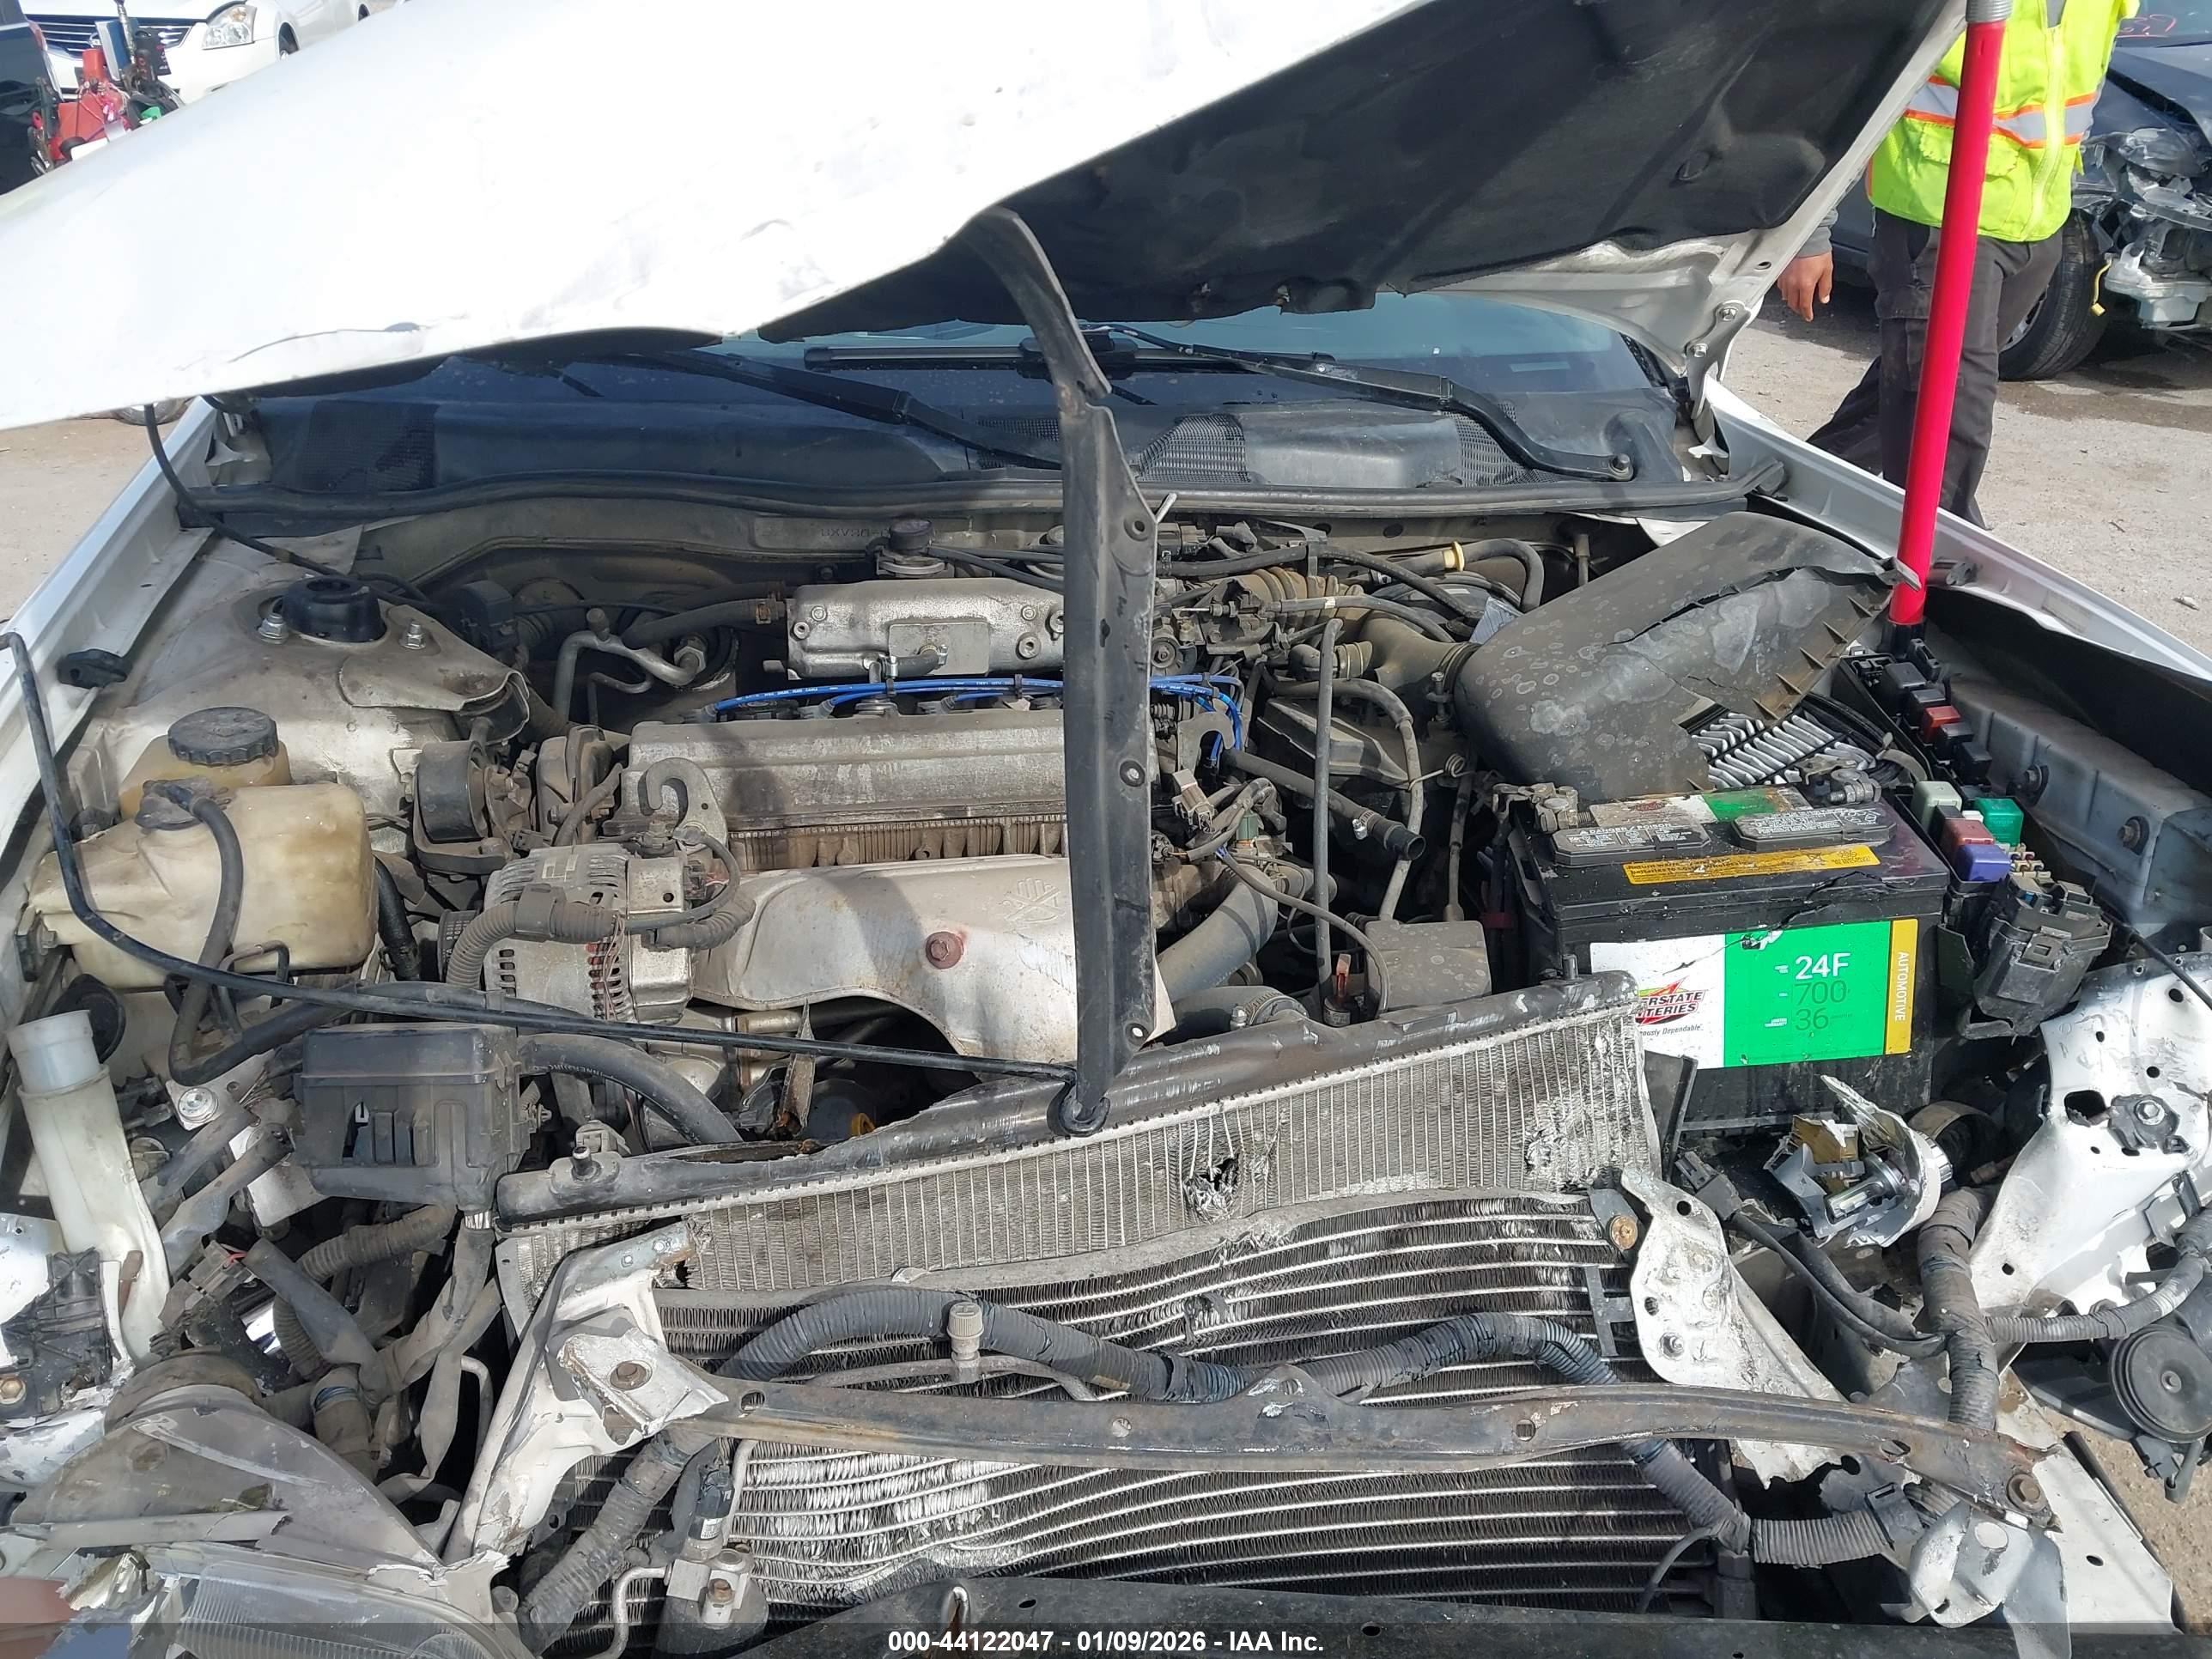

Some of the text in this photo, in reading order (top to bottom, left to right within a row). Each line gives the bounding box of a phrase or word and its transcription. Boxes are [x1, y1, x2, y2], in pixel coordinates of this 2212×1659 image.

[1637, 823, 1672, 831] POISON
[1796, 951, 1850, 980] 24F
[1795, 980, 1847, 1006] 700
[1894, 951, 1910, 1022] AUTOMOTIVE
[1662, 1024, 1702, 1035] Dependable
[1796, 1007, 1829, 1031] 36
